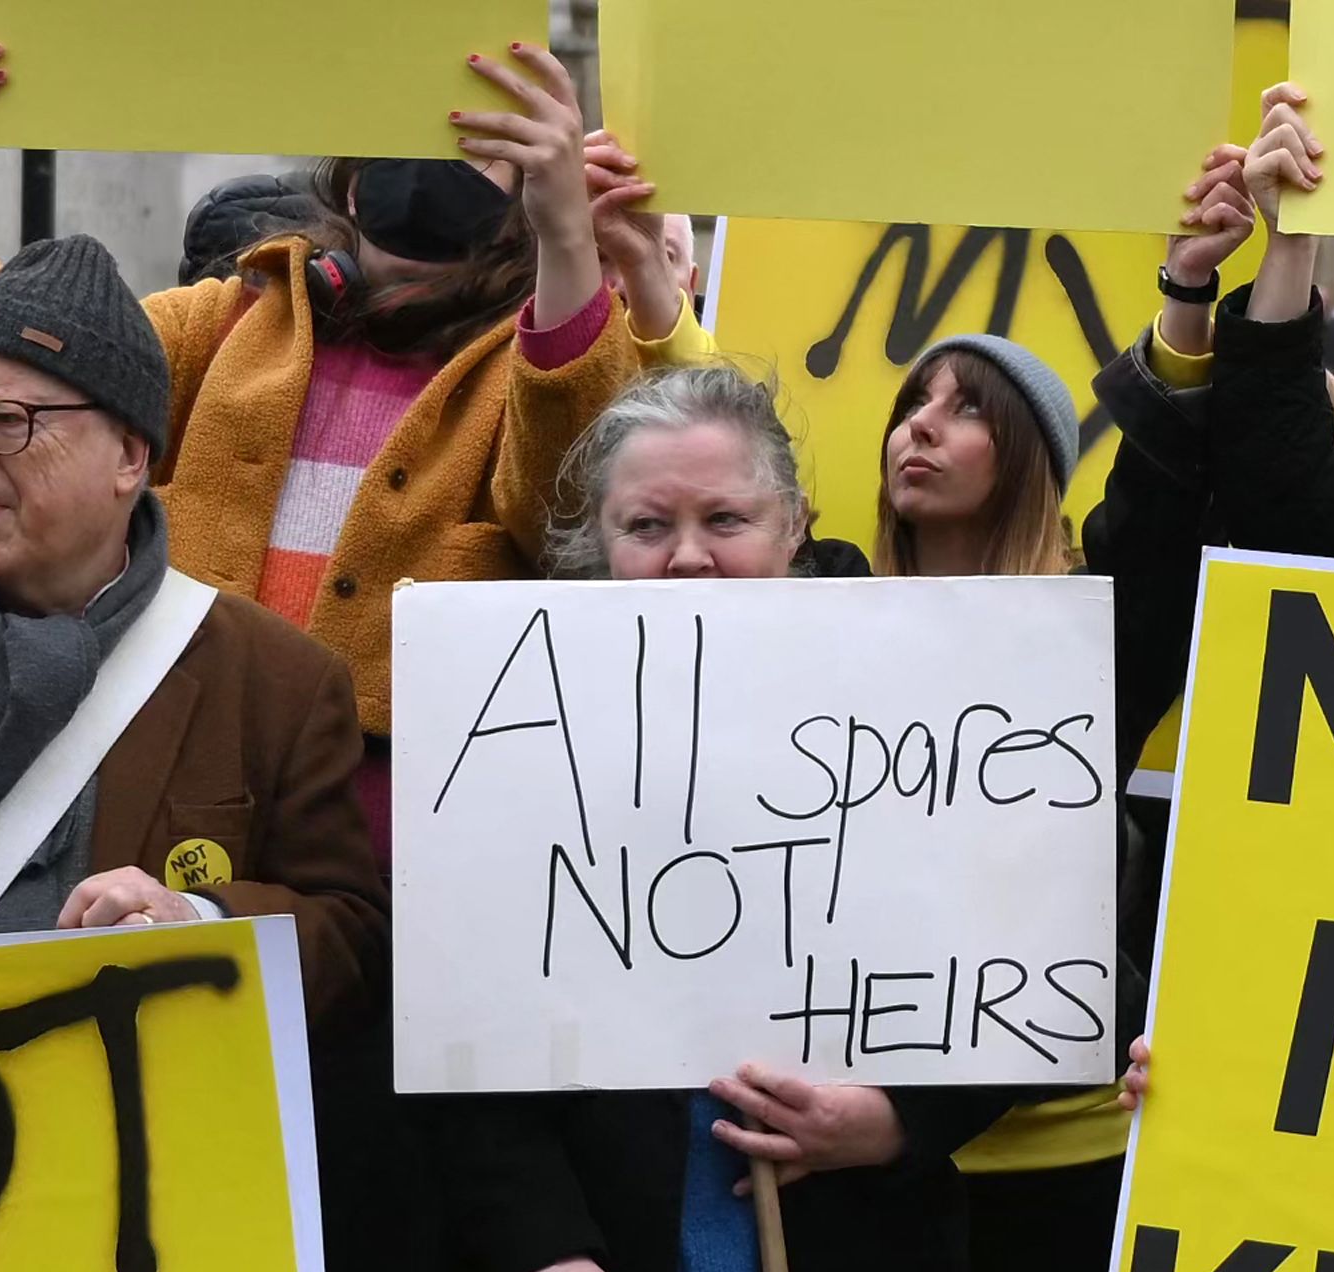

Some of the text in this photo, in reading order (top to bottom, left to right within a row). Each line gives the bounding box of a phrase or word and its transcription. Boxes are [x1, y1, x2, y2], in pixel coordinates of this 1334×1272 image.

[432, 608, 1103, 923] All spares
[170, 844, 206, 872] NOT
[183, 863, 208, 886] MY
[543, 837, 832, 978] NOT
[770, 954, 1108, 1066] HEIRS
